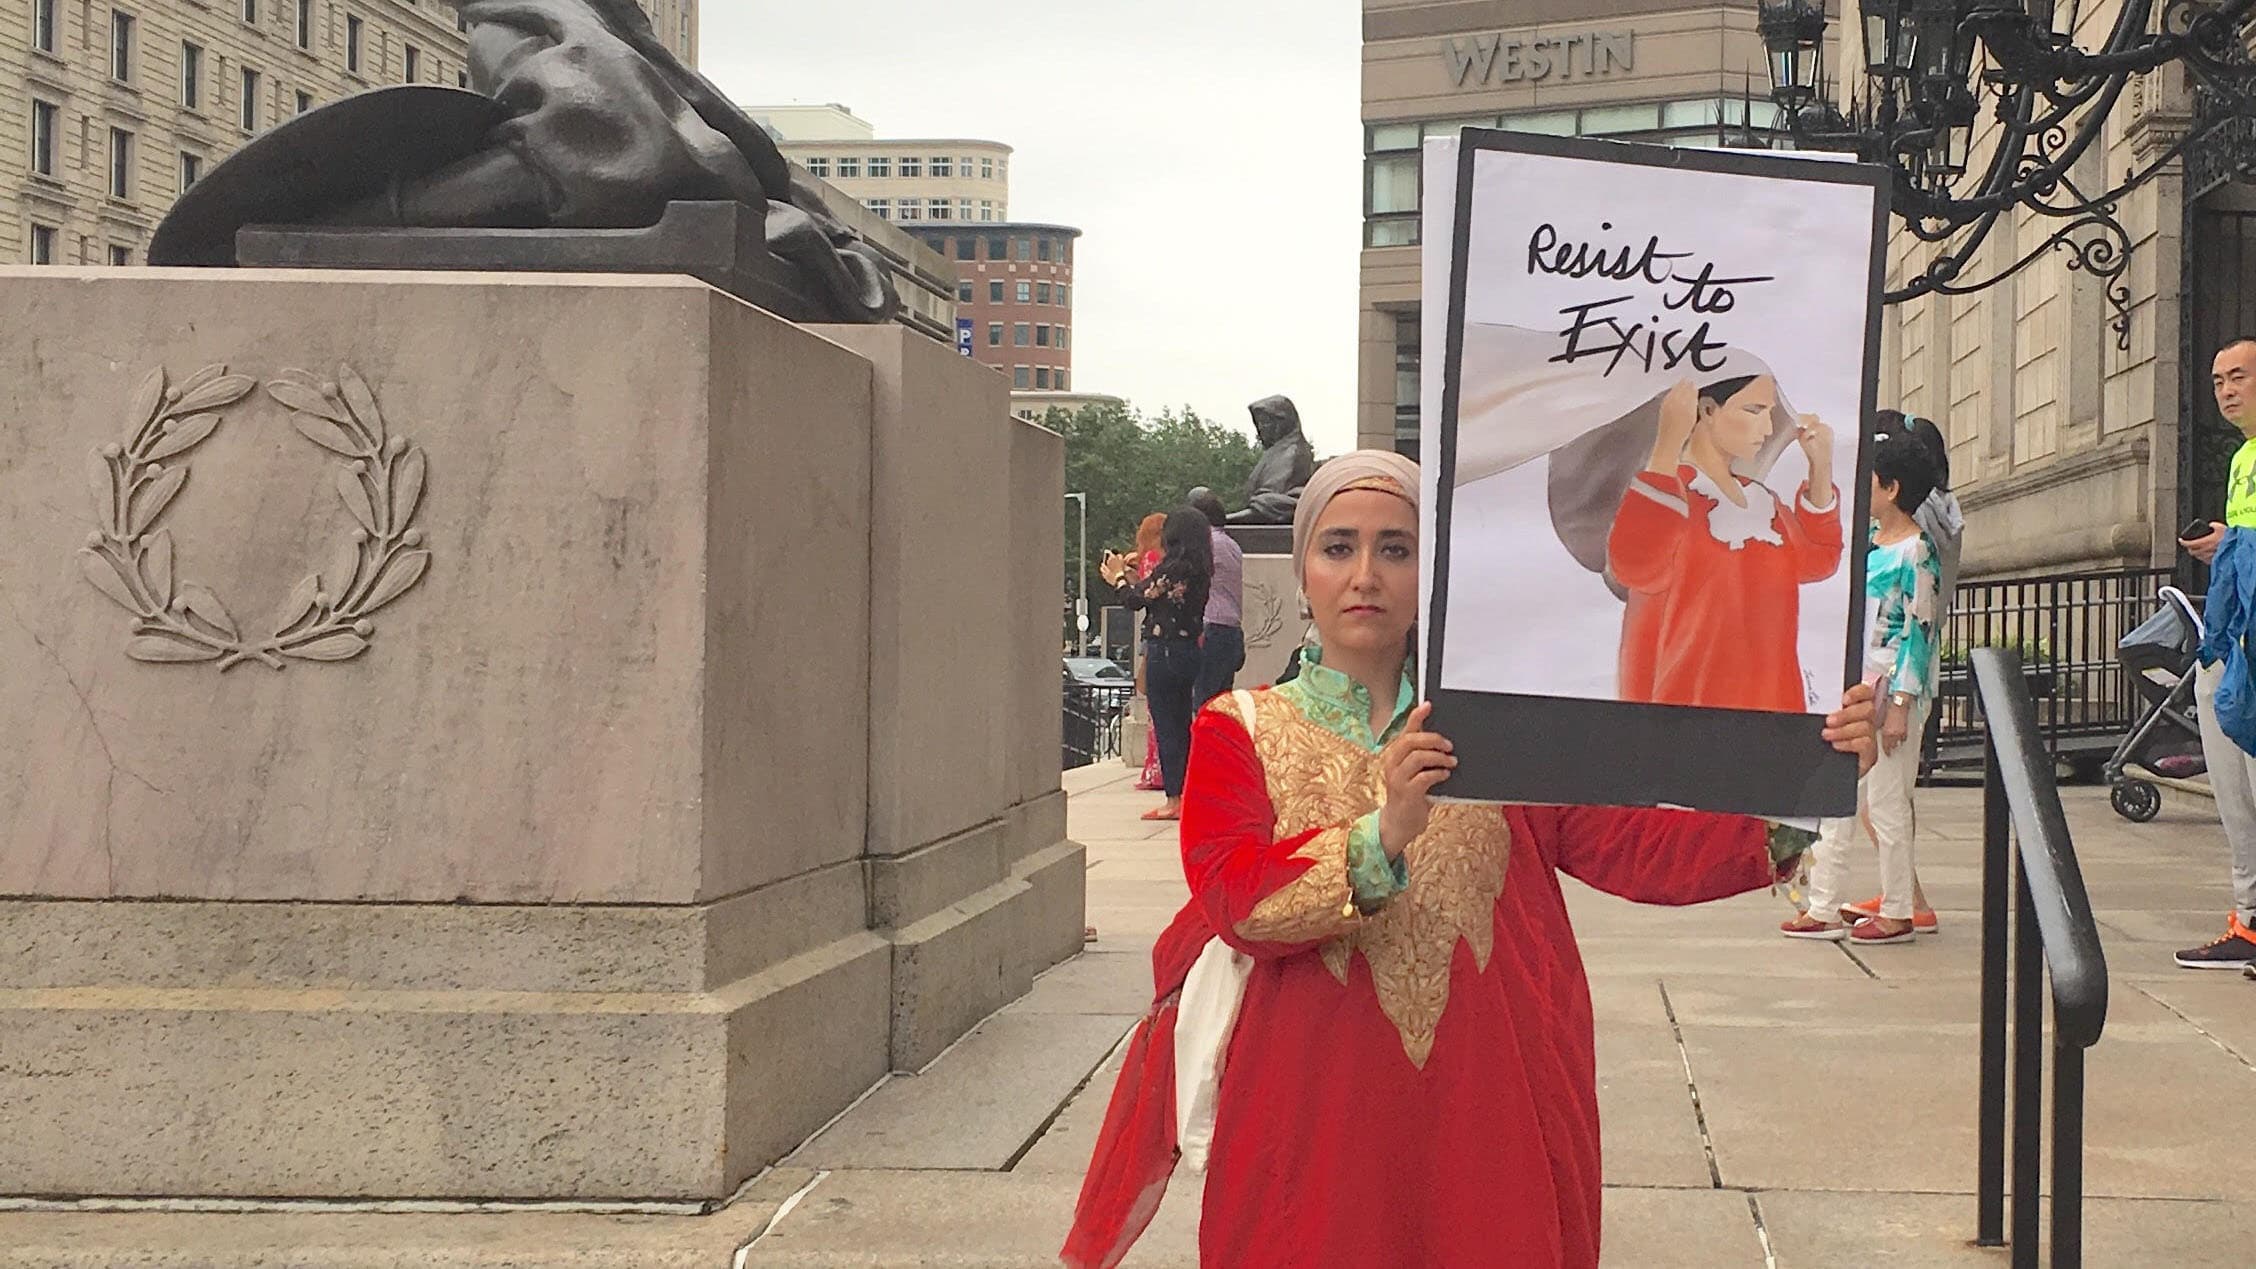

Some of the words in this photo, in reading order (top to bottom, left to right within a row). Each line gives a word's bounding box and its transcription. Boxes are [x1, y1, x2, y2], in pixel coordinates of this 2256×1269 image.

[1442, 29, 1634, 86] WESTIN
[1527, 222, 1694, 284] Resist
[1662, 262, 1775, 313] to
[960, 329, 971, 344] P
[1548, 295, 1728, 378] Exist
